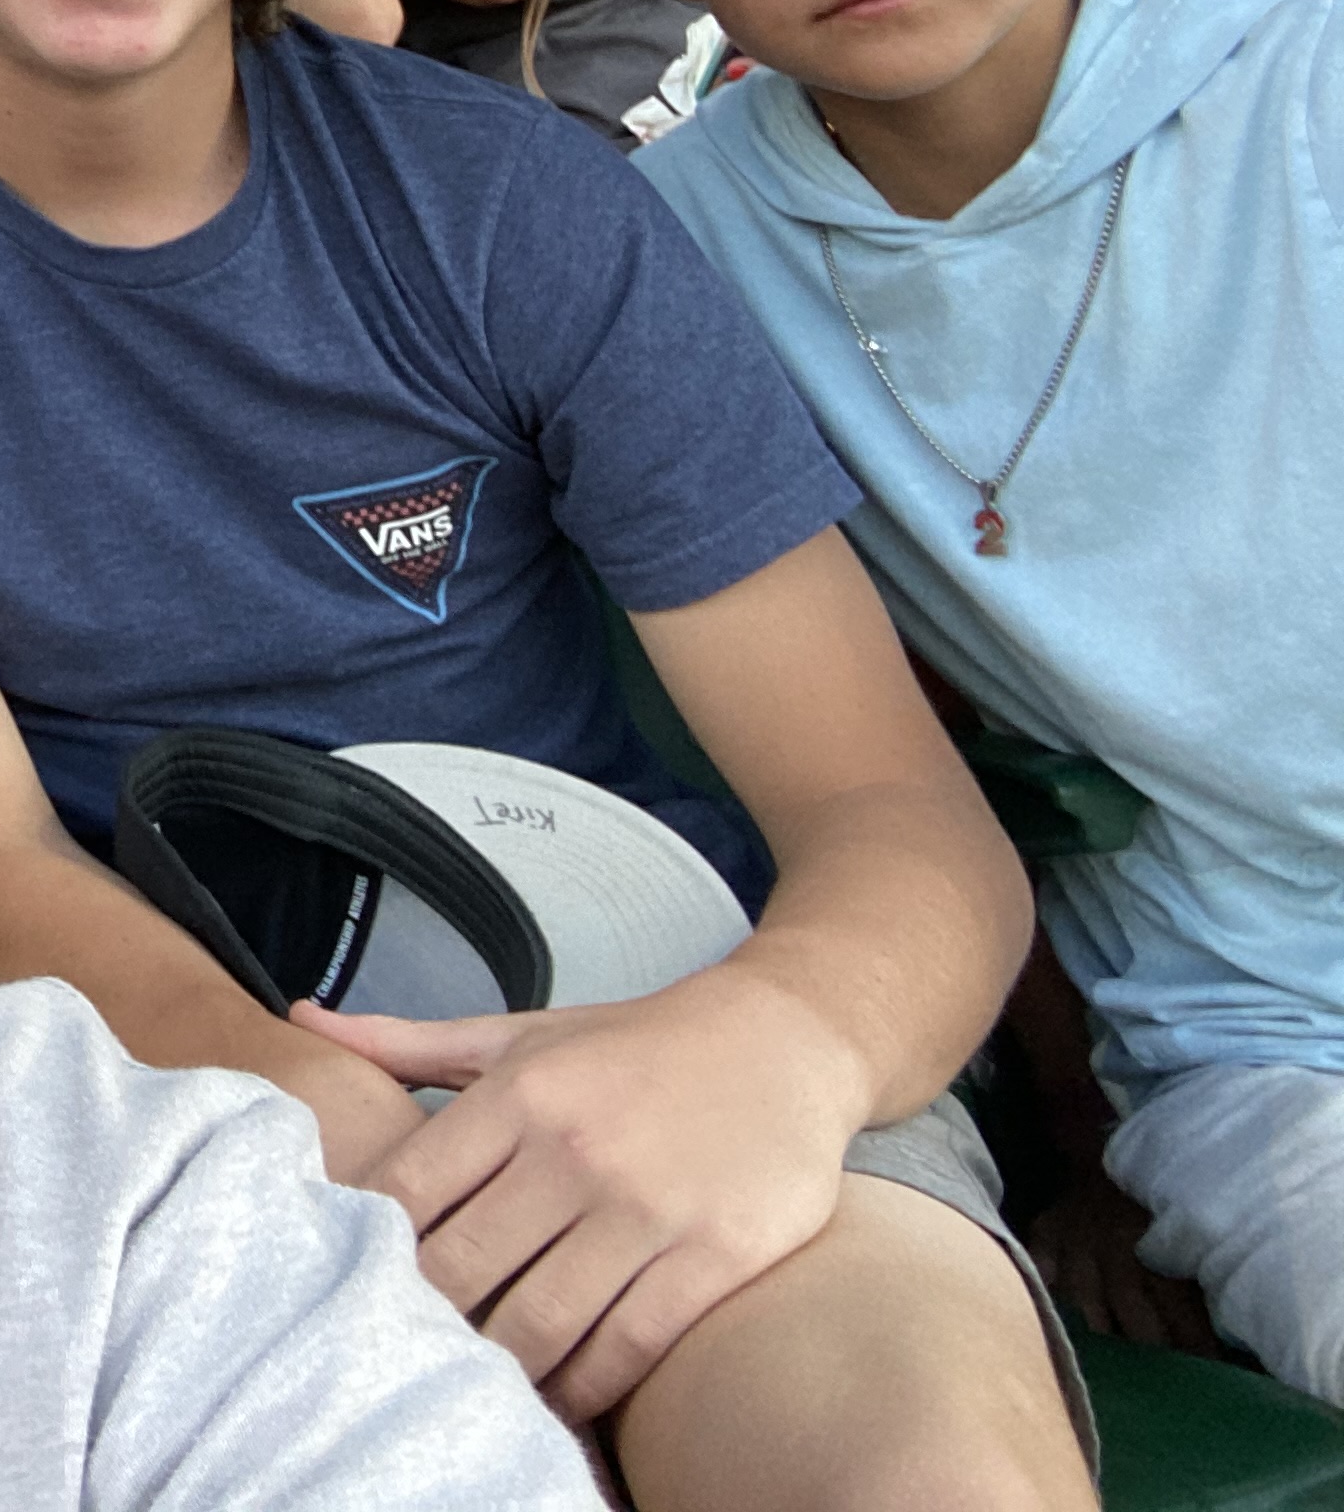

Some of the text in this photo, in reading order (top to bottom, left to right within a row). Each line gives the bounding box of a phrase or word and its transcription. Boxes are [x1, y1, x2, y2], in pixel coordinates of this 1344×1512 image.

[357, 504, 454, 558] VANS
[975, 509, 1008, 557] 2
[315, 918, 357, 999] CHAMPIONSHIP
